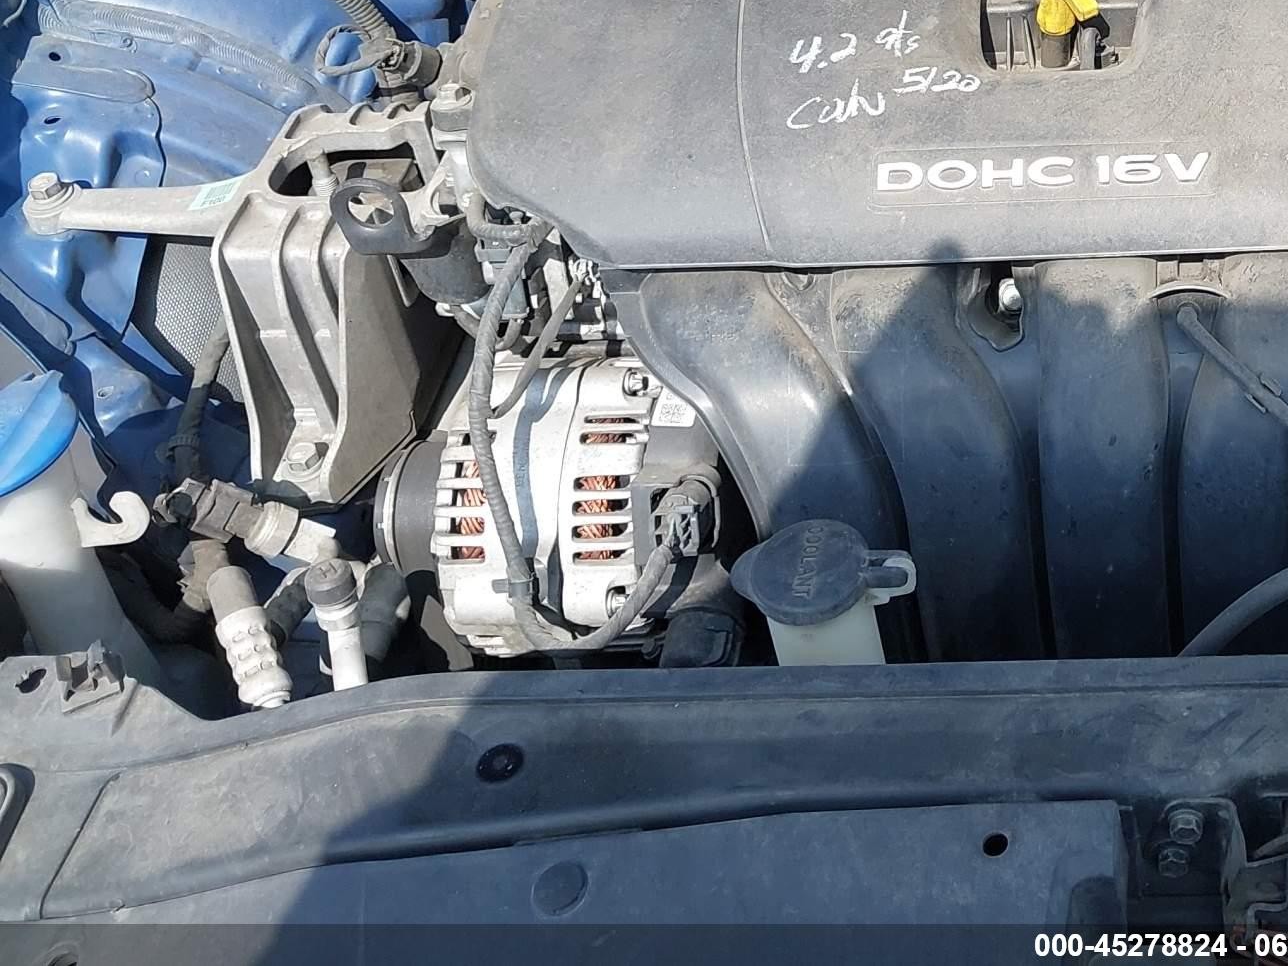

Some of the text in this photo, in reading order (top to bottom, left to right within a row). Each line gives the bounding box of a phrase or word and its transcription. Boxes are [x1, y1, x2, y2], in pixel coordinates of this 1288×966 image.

[876, 151, 1211, 192] DOHC 16V
[791, 525, 825, 601] COOLANT
